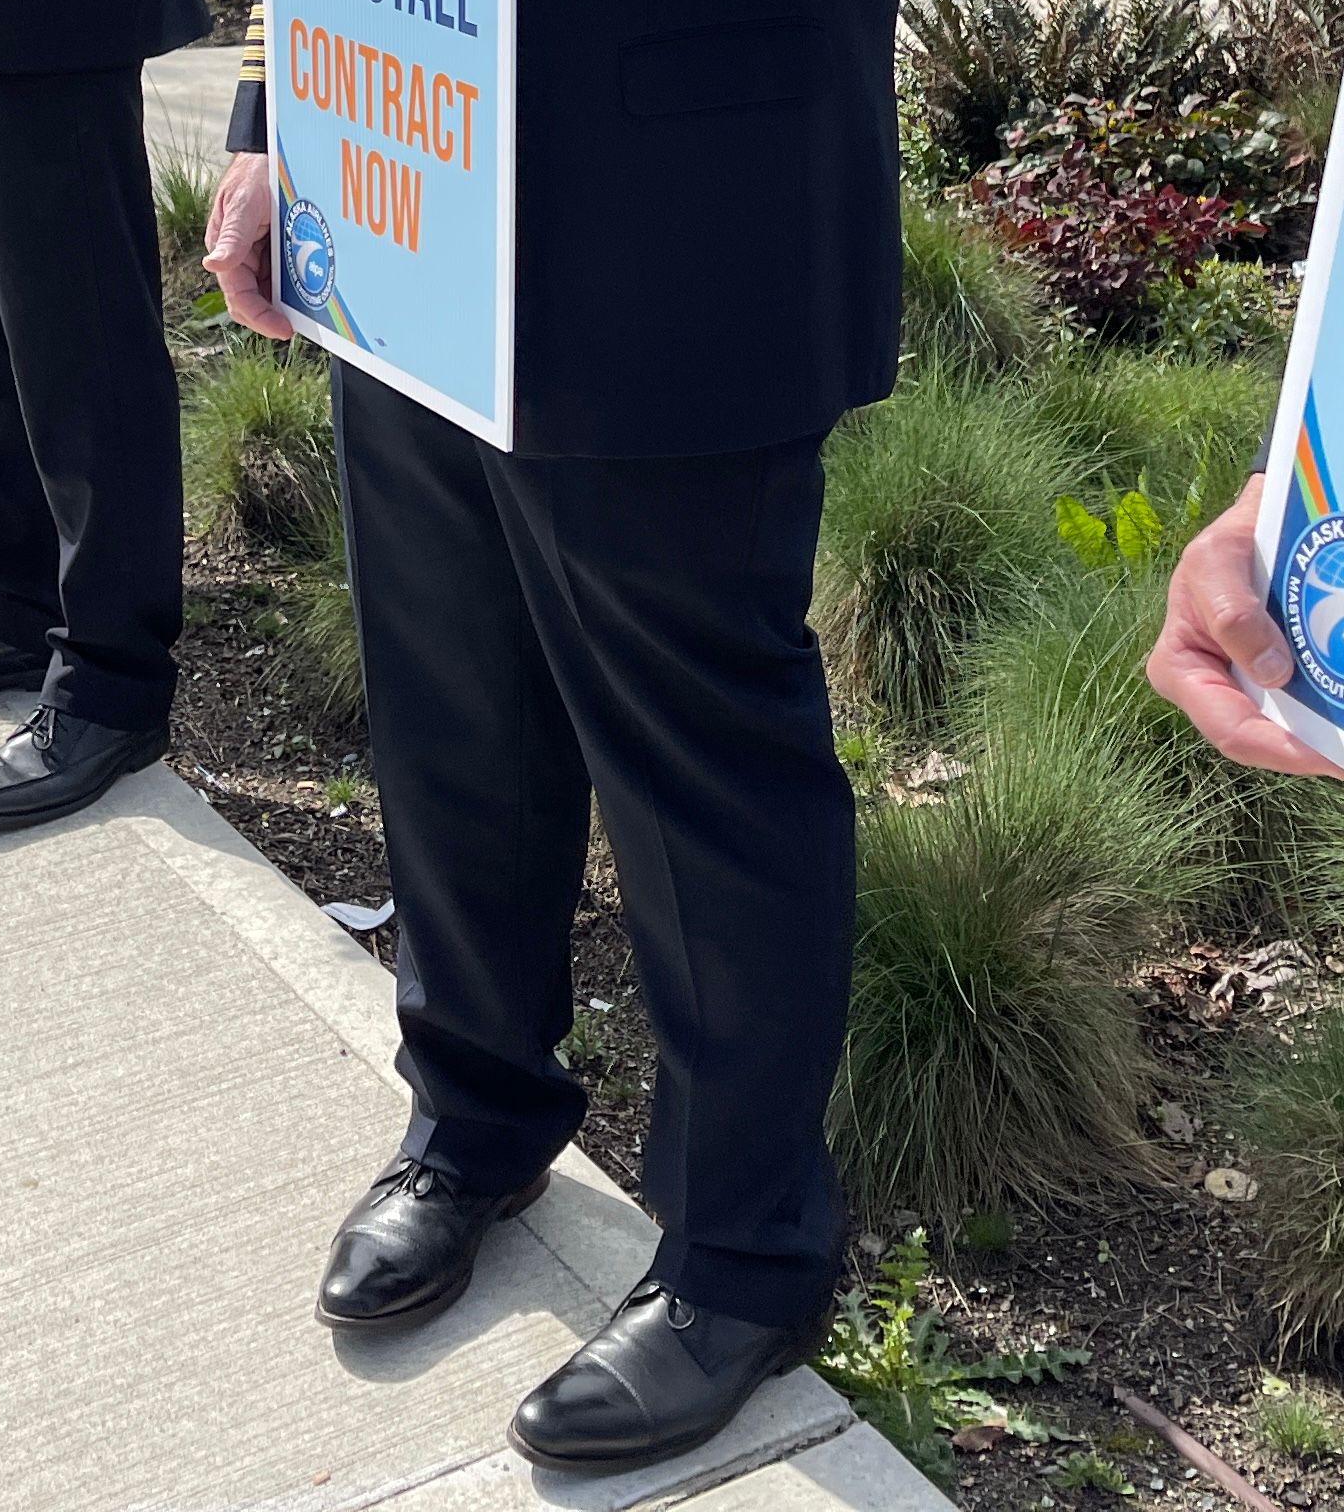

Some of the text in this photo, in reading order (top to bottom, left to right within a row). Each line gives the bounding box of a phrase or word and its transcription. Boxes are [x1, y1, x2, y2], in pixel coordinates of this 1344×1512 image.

[289, 17, 479, 172] CONTRACT
[341, 137, 423, 254] NOW
[1288, 575, 1307, 649] MASTER
